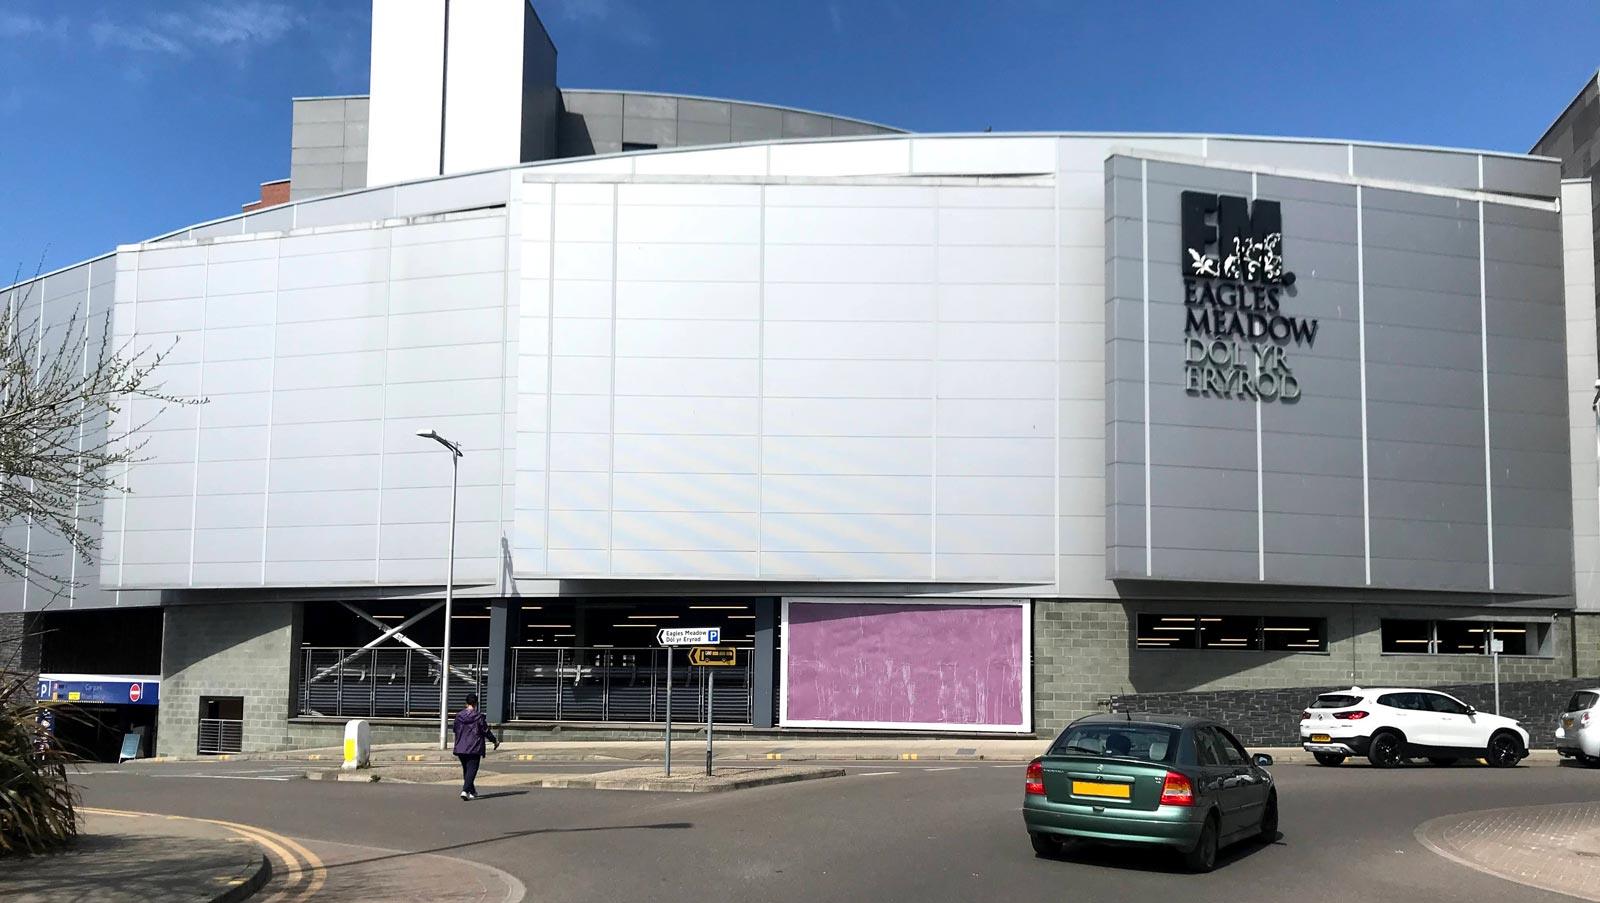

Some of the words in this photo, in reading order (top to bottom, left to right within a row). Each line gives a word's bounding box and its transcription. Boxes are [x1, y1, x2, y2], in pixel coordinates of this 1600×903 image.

[1183, 278, 1280, 312] EAGLES
[1184, 308, 1318, 344] MEADOW
[1252, 343, 1291, 373] YR
[1185, 366, 1301, 400] ERYROD
[710, 631, 717, 641] P
